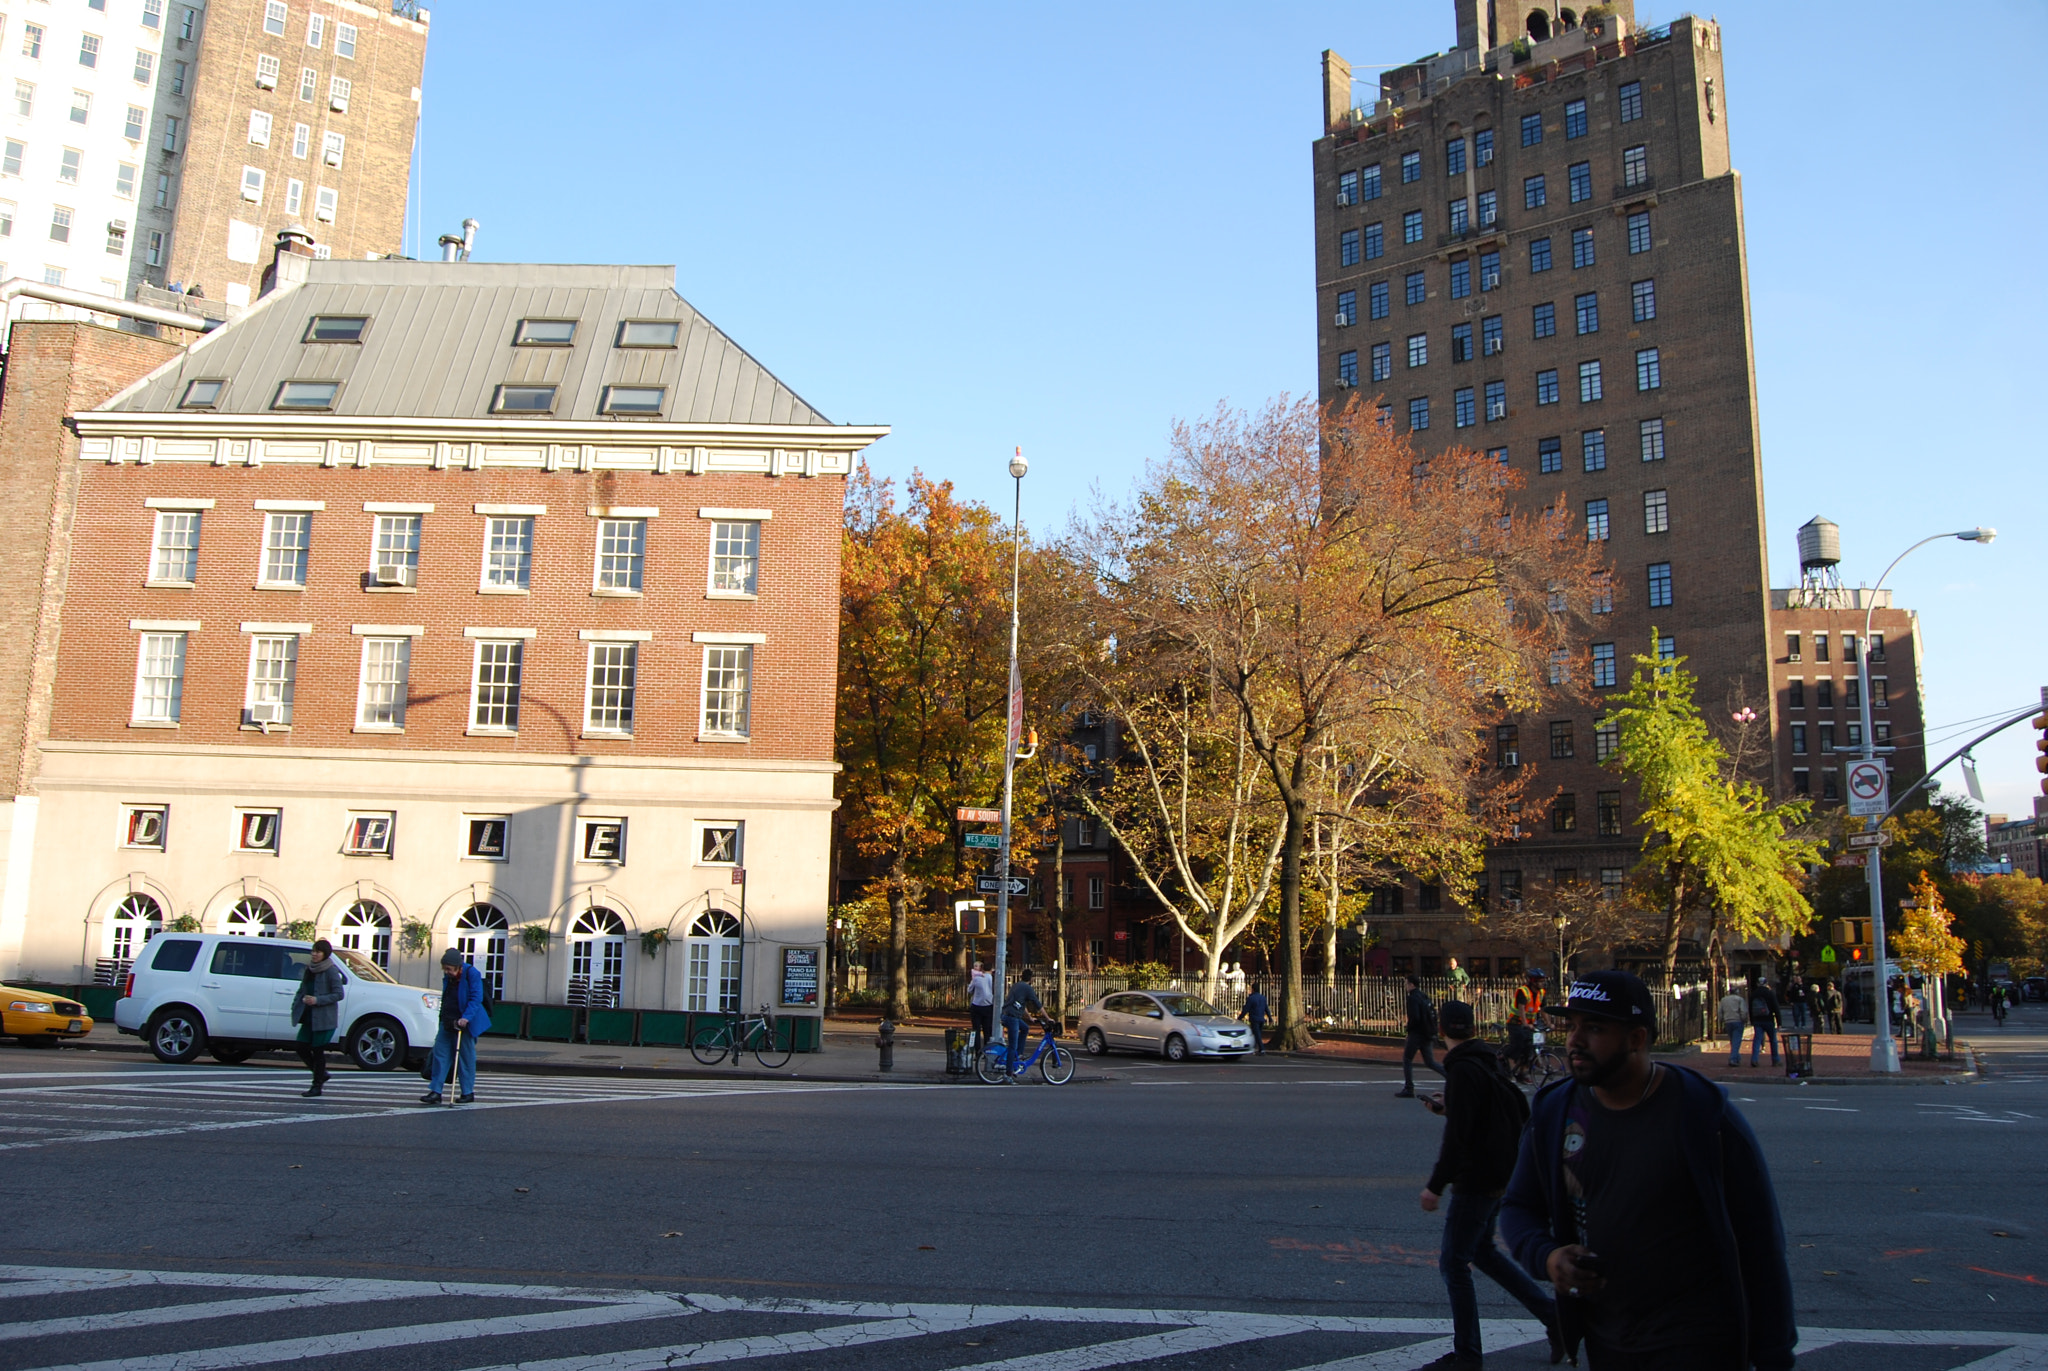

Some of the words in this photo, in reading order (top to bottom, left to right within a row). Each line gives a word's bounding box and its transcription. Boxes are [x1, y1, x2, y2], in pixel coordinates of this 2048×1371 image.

[960, 810, 965, 820] 7
[967, 810, 976, 820] AV
[978, 811, 999, 821] SOUTH
[966, 835, 979, 843] WES
[984, 881, 1000, 889] ONE
